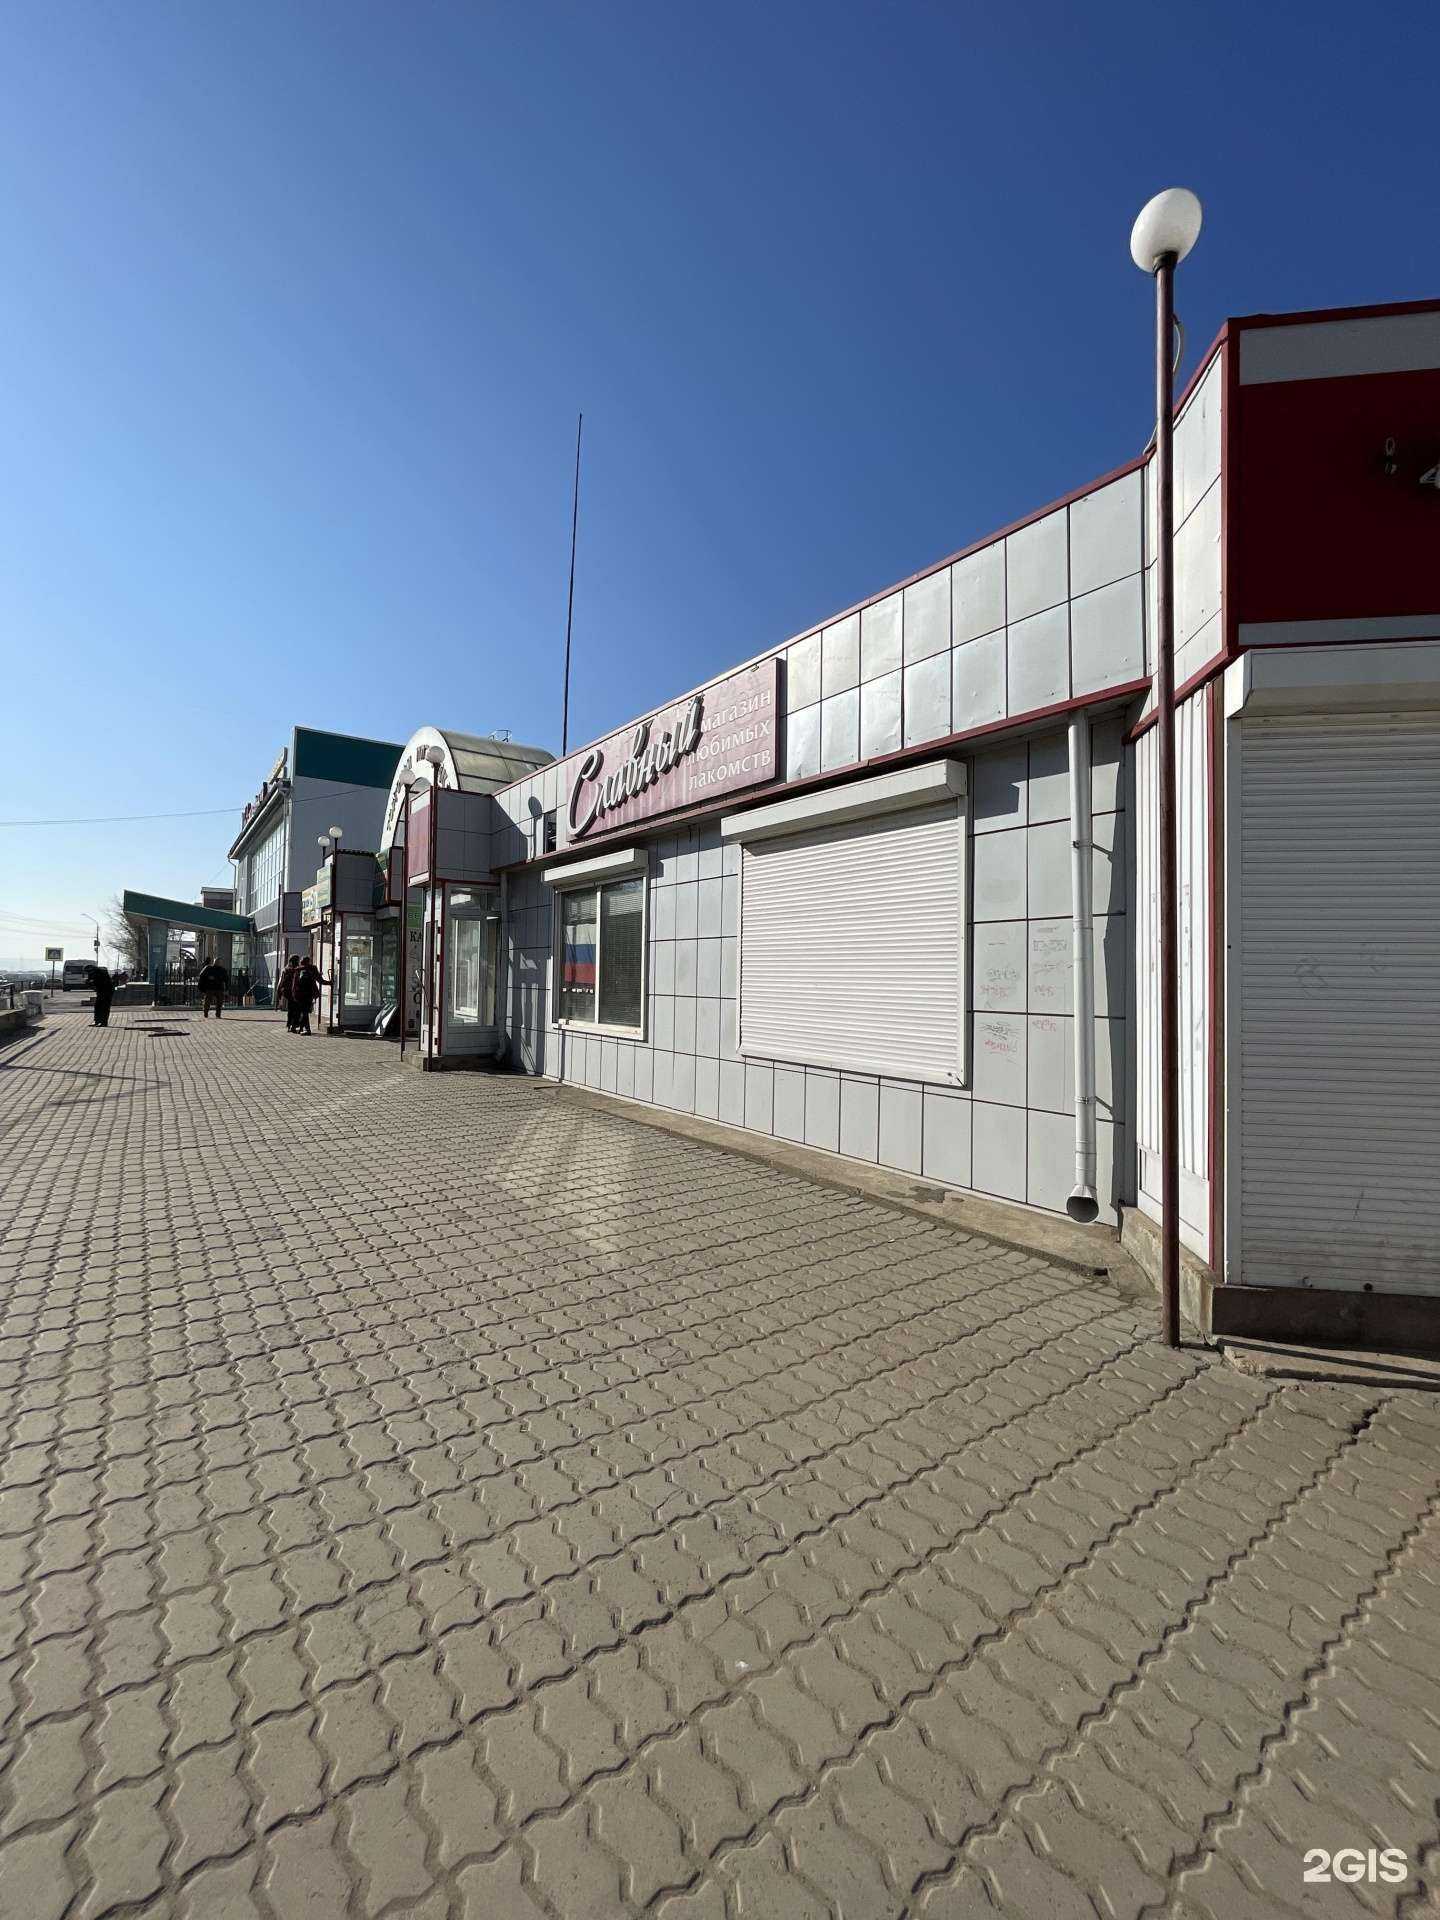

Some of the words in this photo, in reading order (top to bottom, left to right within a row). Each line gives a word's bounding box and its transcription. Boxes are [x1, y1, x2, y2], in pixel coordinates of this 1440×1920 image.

[700, 689, 771, 733] магазин
[567, 692, 705, 838] Славный
[687, 719, 771, 766] любимых
[688, 749, 771, 791] лакомств
